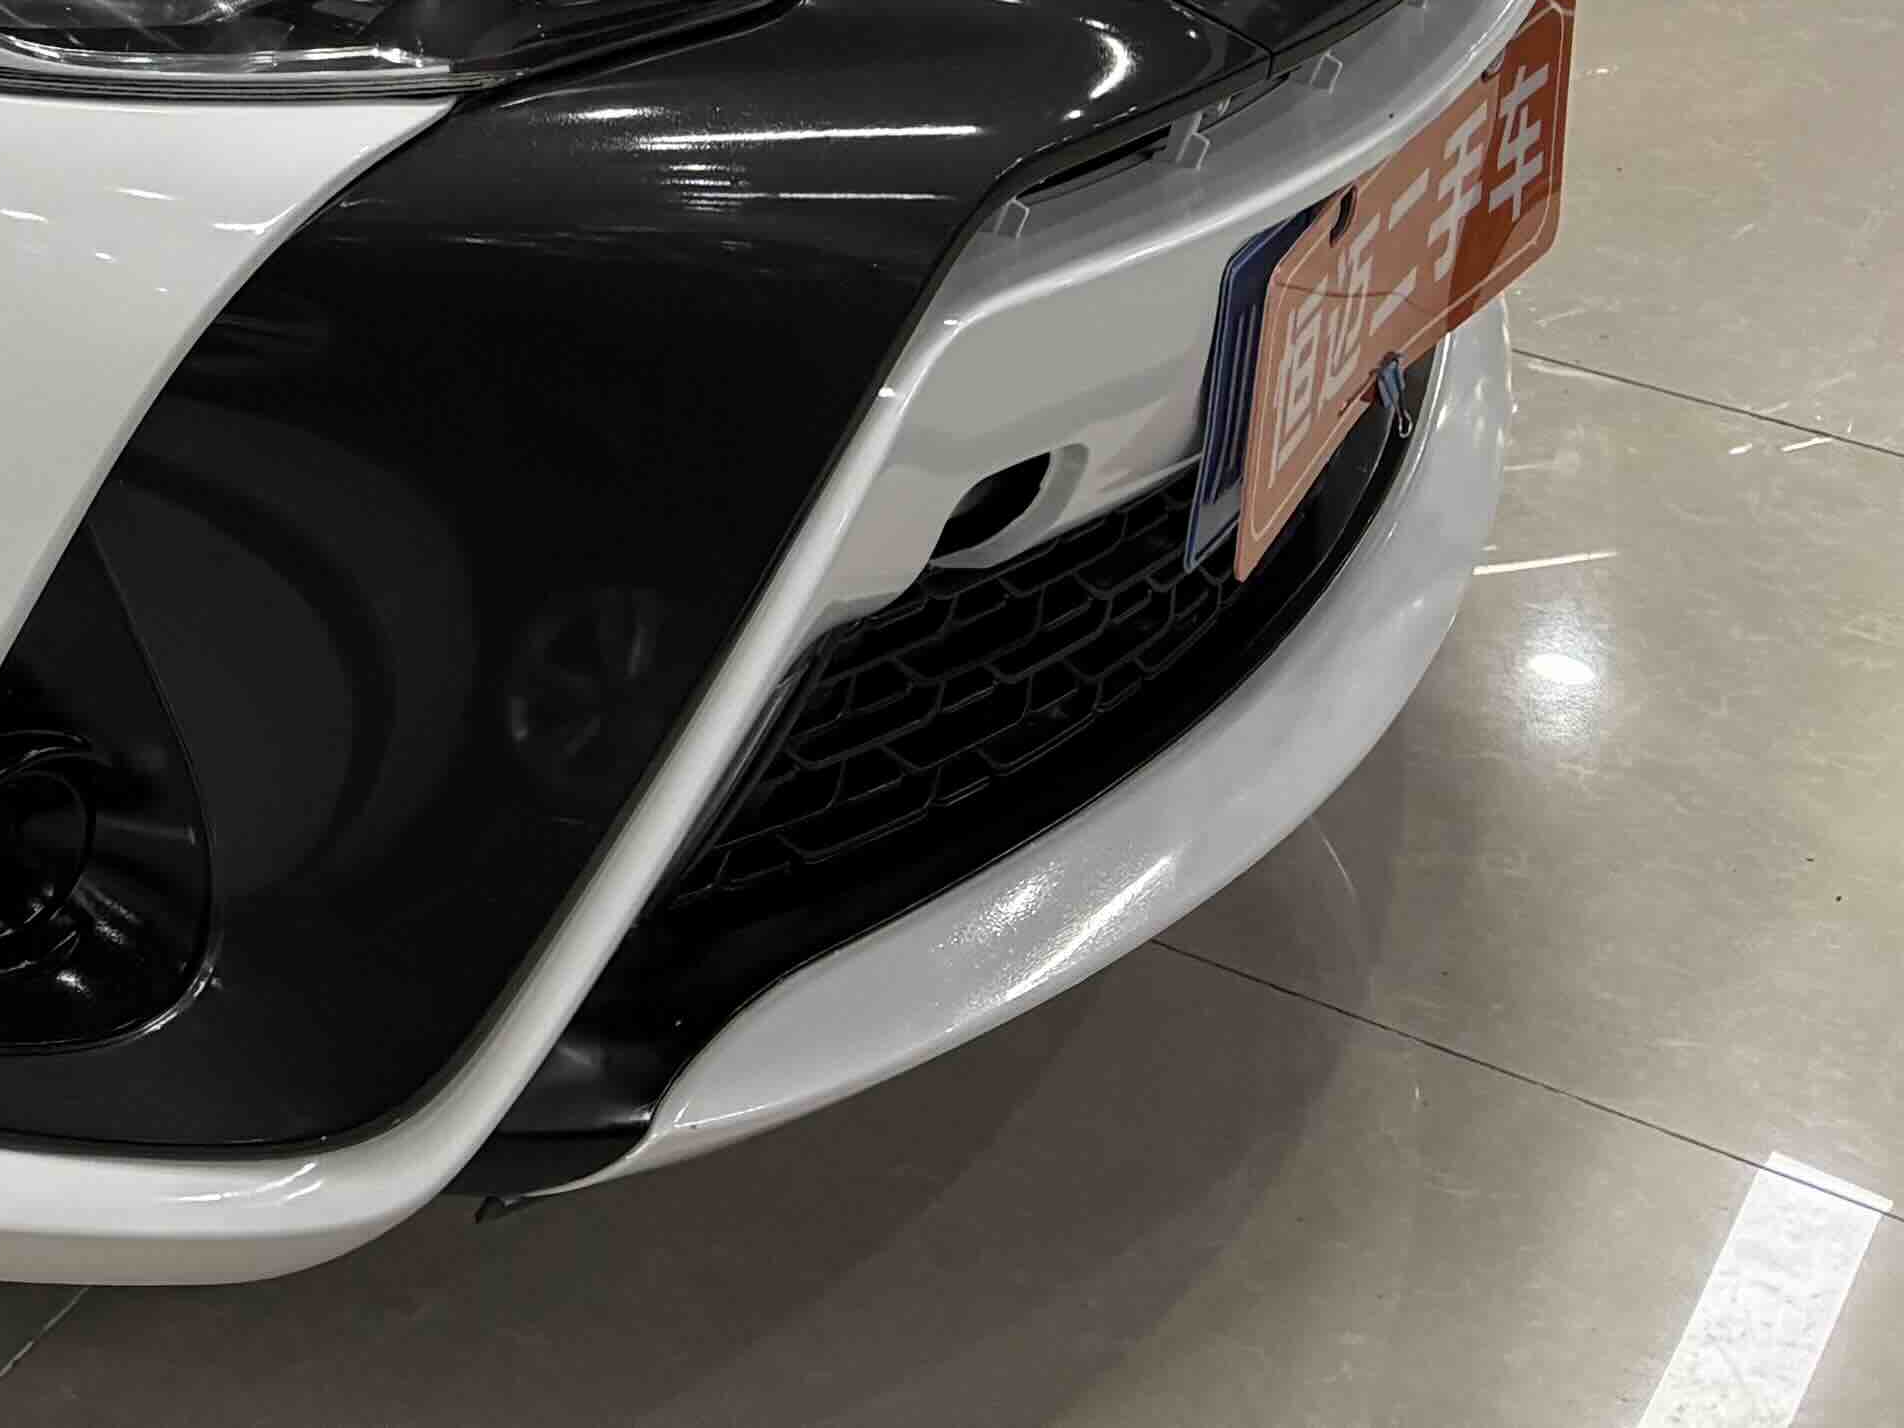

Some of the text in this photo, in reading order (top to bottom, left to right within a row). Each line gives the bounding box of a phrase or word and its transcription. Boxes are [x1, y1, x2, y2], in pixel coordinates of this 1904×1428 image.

[1268, 63, 1550, 489] 恒迈二手车
